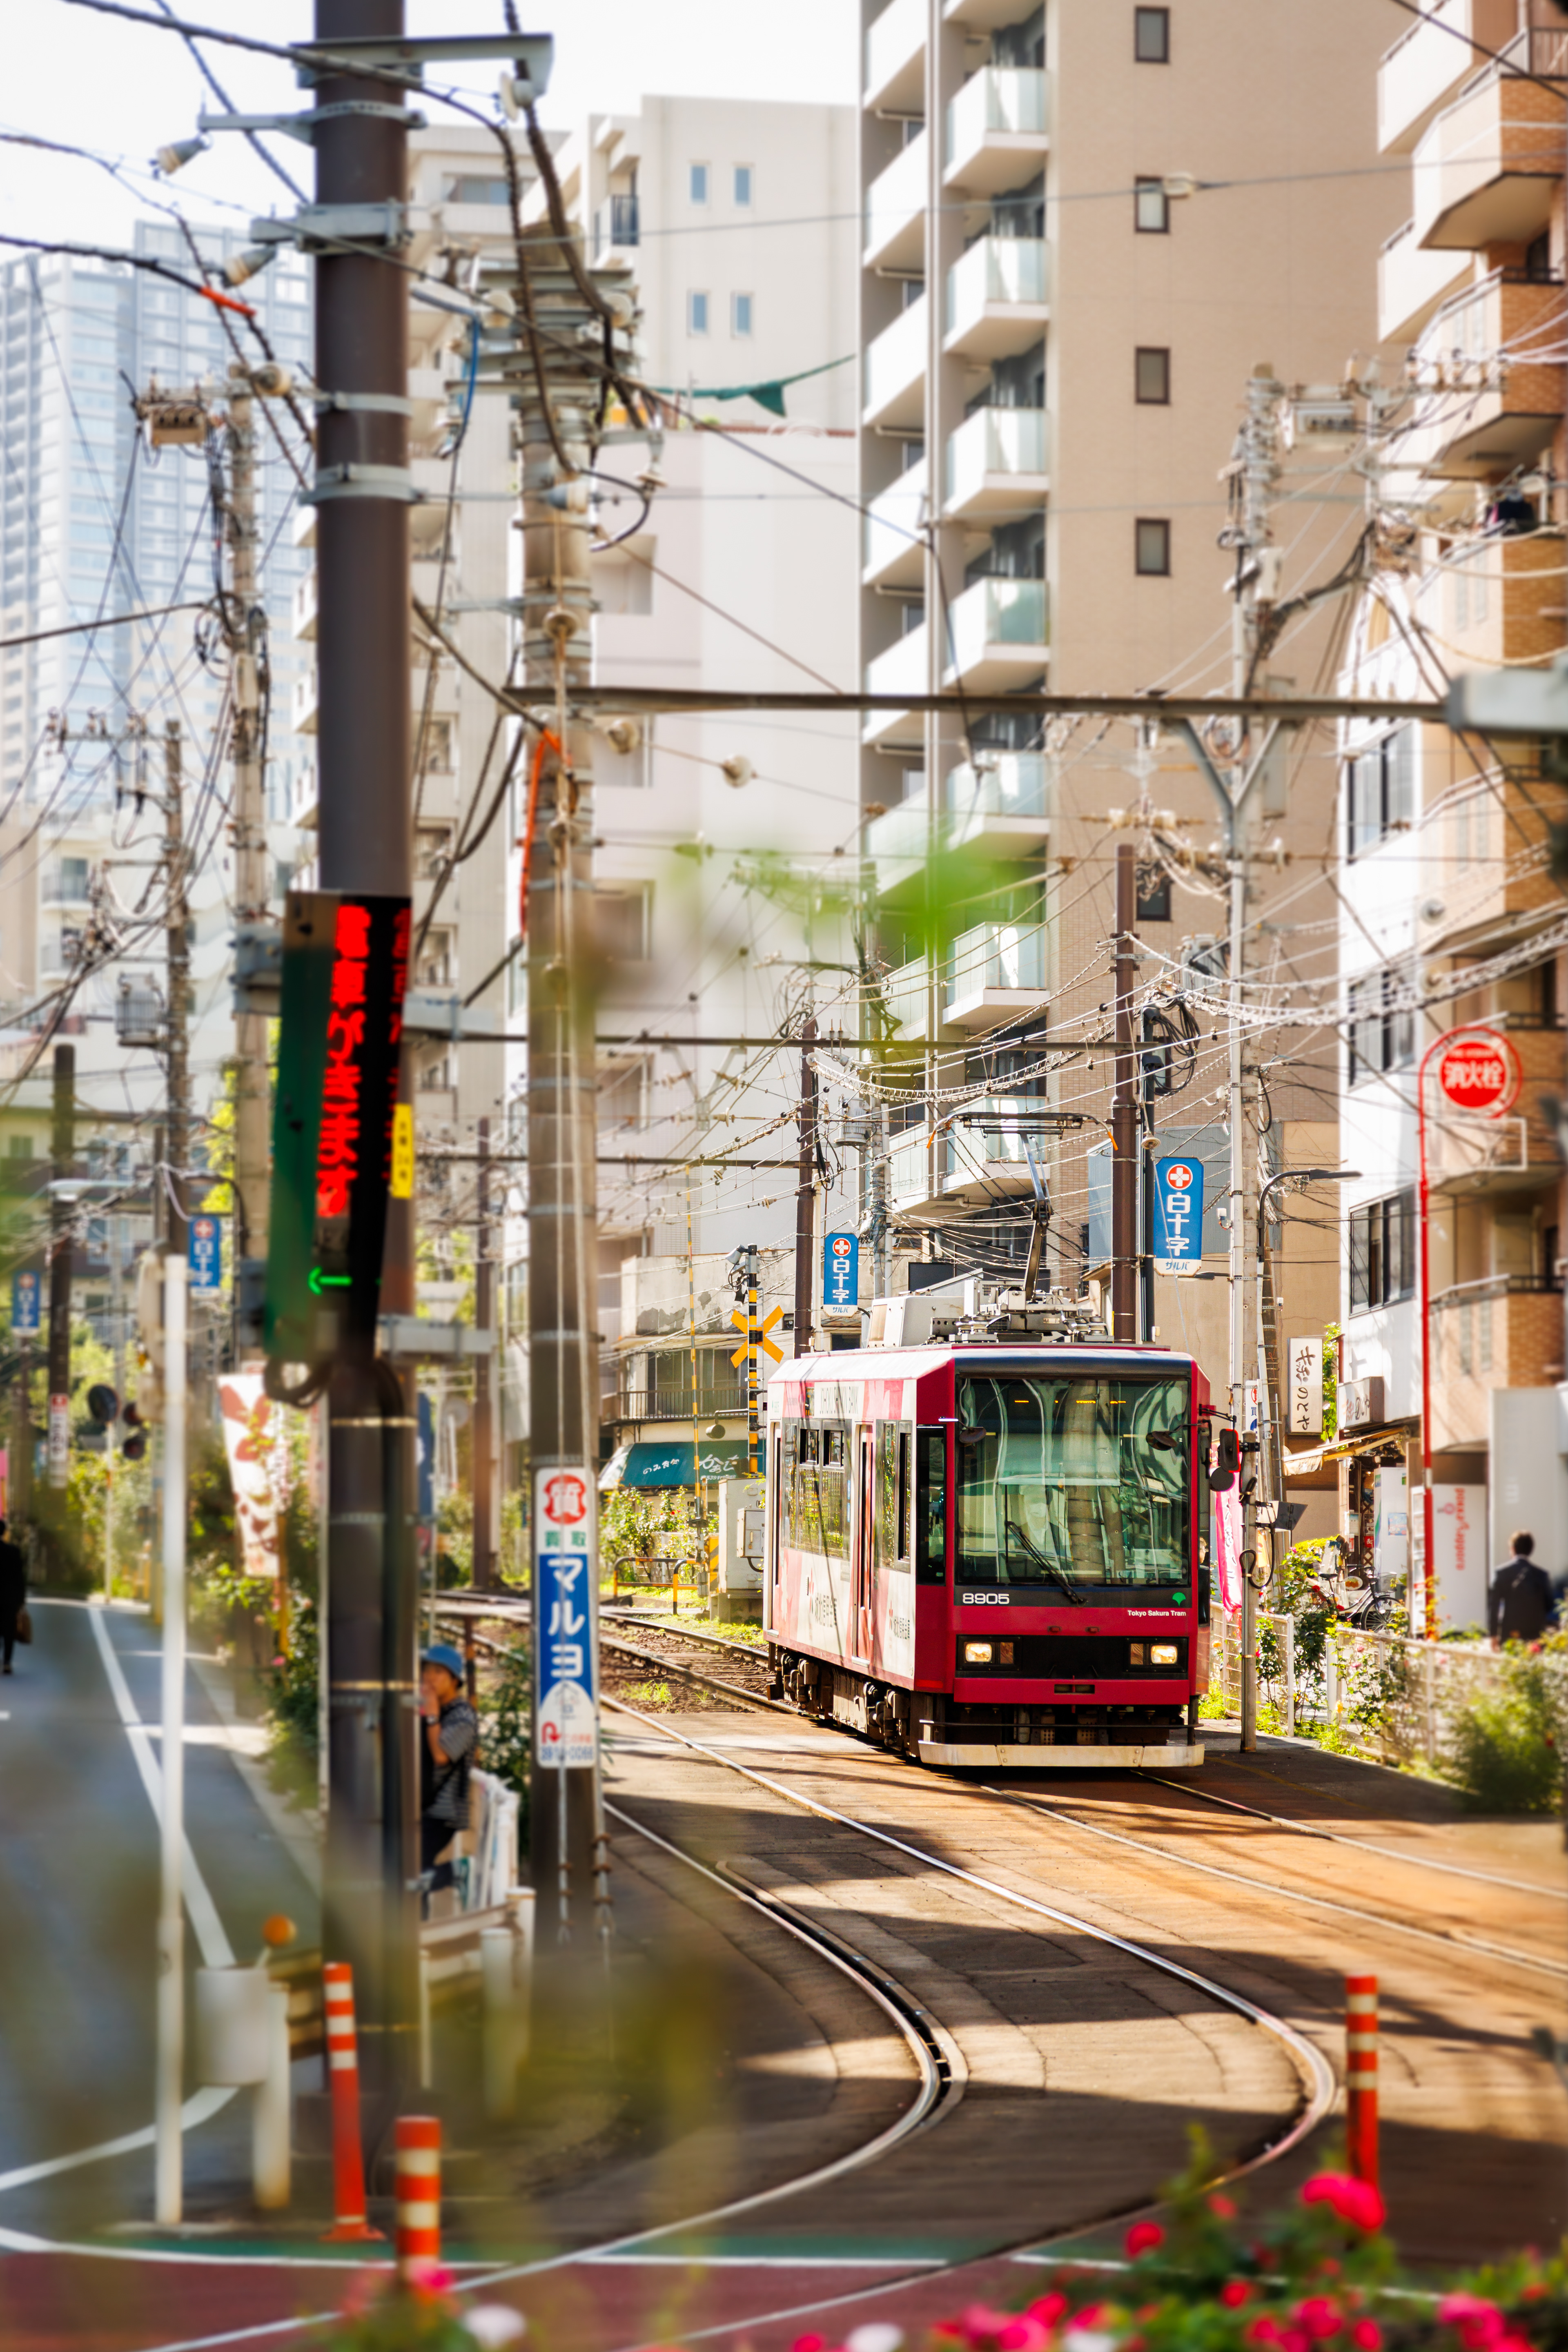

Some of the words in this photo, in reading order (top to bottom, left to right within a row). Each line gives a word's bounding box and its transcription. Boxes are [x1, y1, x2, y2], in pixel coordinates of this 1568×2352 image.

[1444, 1060, 1503, 1090] 消火栓
[1166, 1192, 1190, 1256] 白十字
[833, 1258, 850, 1303] 白十字
[1165, 1261, 1190, 1271] サルバ
[849, 1387, 858, 1414] BANK
[962, 1593, 1010, 1604] 8905
[548, 1557, 586, 1677] マルヨ
